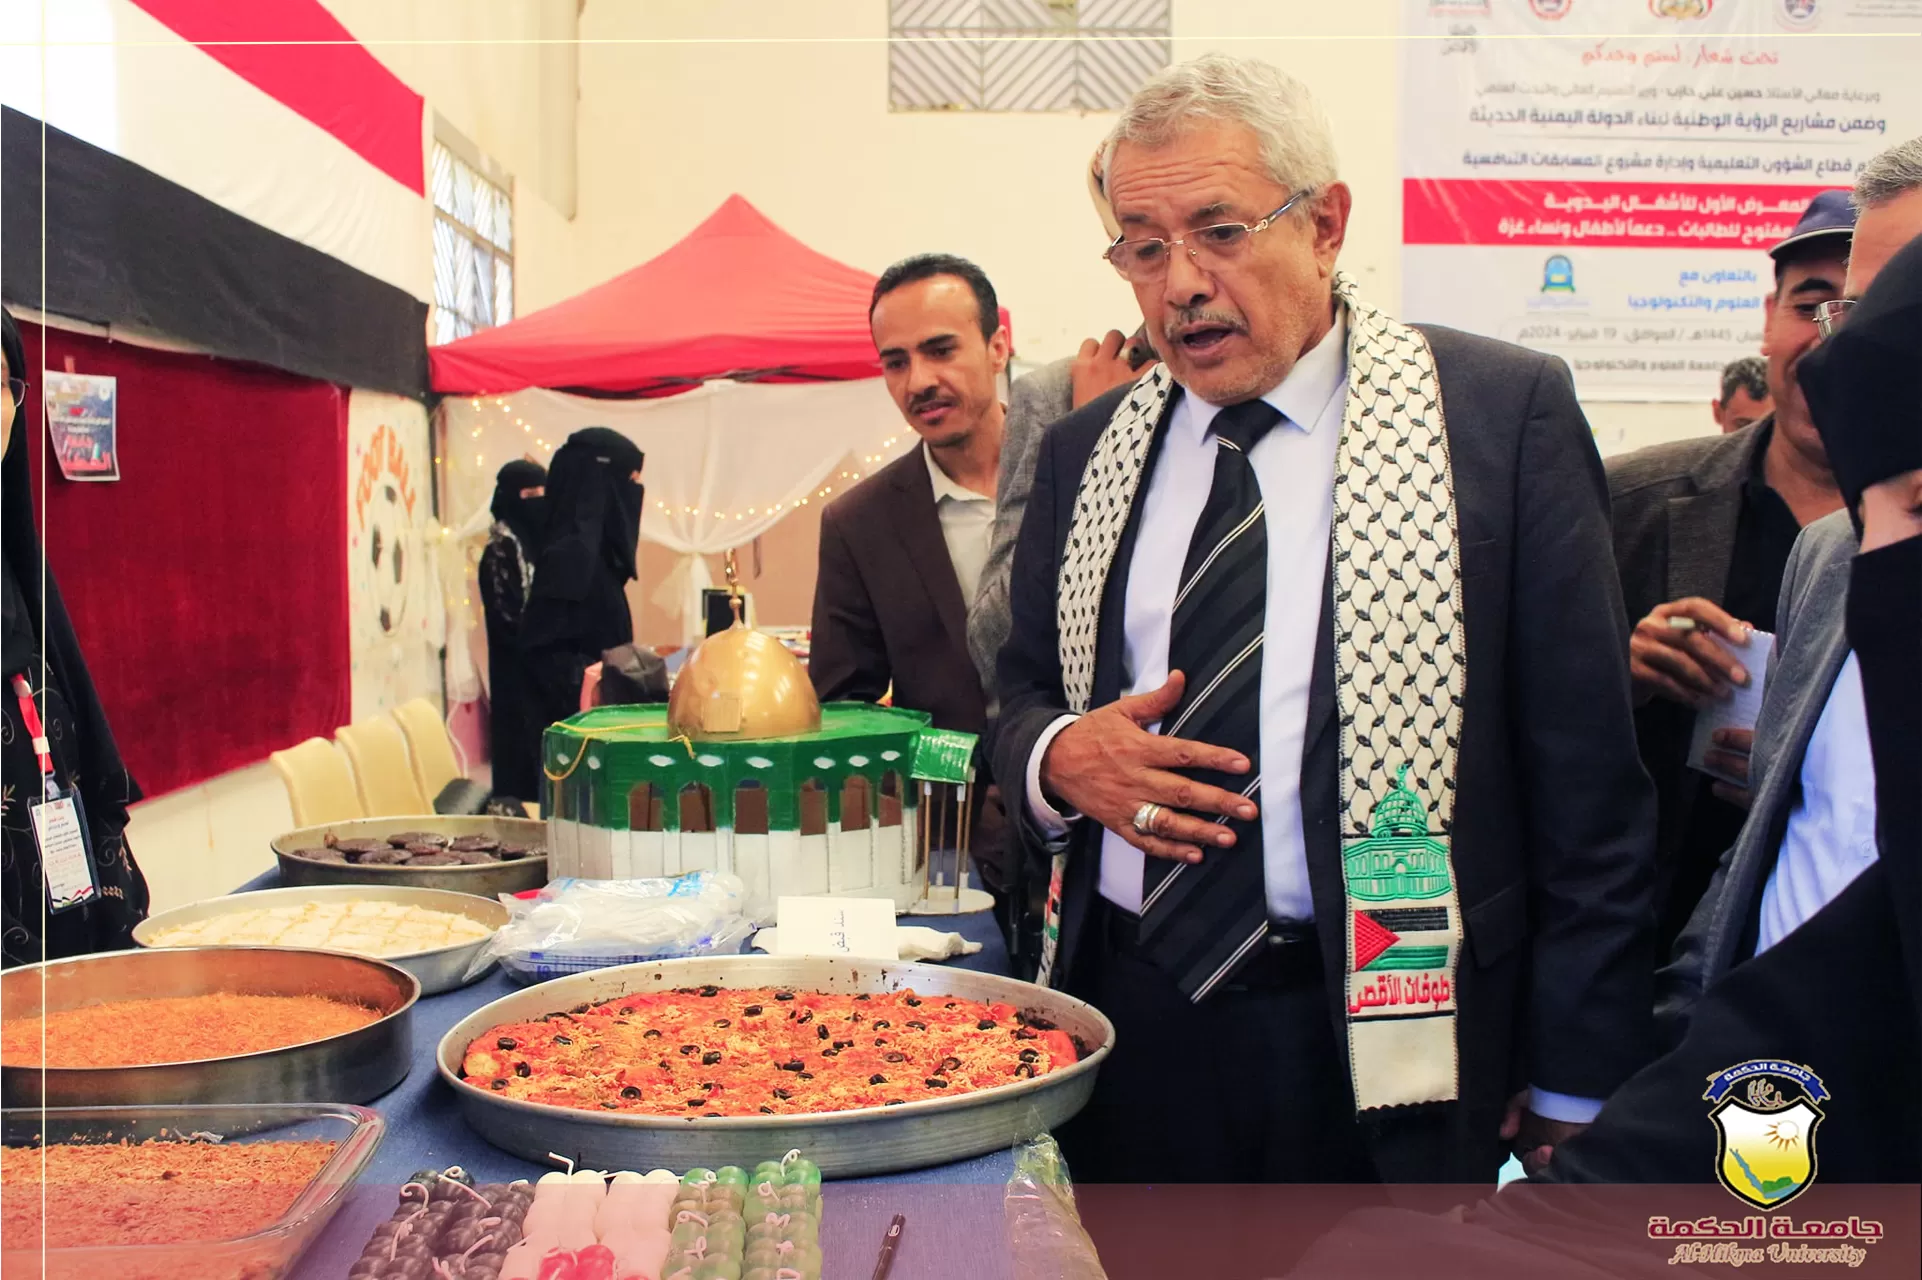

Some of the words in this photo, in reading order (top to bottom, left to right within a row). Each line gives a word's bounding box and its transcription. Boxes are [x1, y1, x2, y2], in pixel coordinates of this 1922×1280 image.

[1740, 49, 1780, 65] تحت
[1699, 84, 1725, 100] علي
[1726, 88, 1763, 101] حسين
[1469, 104, 1526, 128] الحديثة
[1530, 107, 1584, 128] اليمنية
[1587, 109, 1634, 130] الدولة
[1672, 110, 1731, 131] الوطنية
[1734, 111, 1779, 132] الرؤية
[1780, 112, 1836, 135] مشاريع
[1839, 118, 1886, 135] وضمن
[1462, 149, 1528, 169] التنافسية
[1531, 151, 1603, 171] المسابقات
[1604, 151, 1652, 174] مشروع
[1655, 154, 1695, 173] وإدارة
[1699, 155, 1760, 173] التعليمية
[1762, 153, 1813, 174] الشؤون
[1815, 158, 1852, 177] قطاع
[1699, 194, 1736, 216] الأول
[1498, 216, 1526, 238] غزة
[1527, 218, 1572, 239] ونساء
[1572, 218, 1629, 238] لأطفال
[1677, 220, 1741, 241] للطالبات
[1678, 271, 1700, 288] مع
[1702, 268, 1757, 286] بالتعاون
[1627, 294, 1712, 312] والتكنولوجيا
[1714, 295, 1761, 312] العلوم
[1404, 972, 1450, 1011] طوفان
